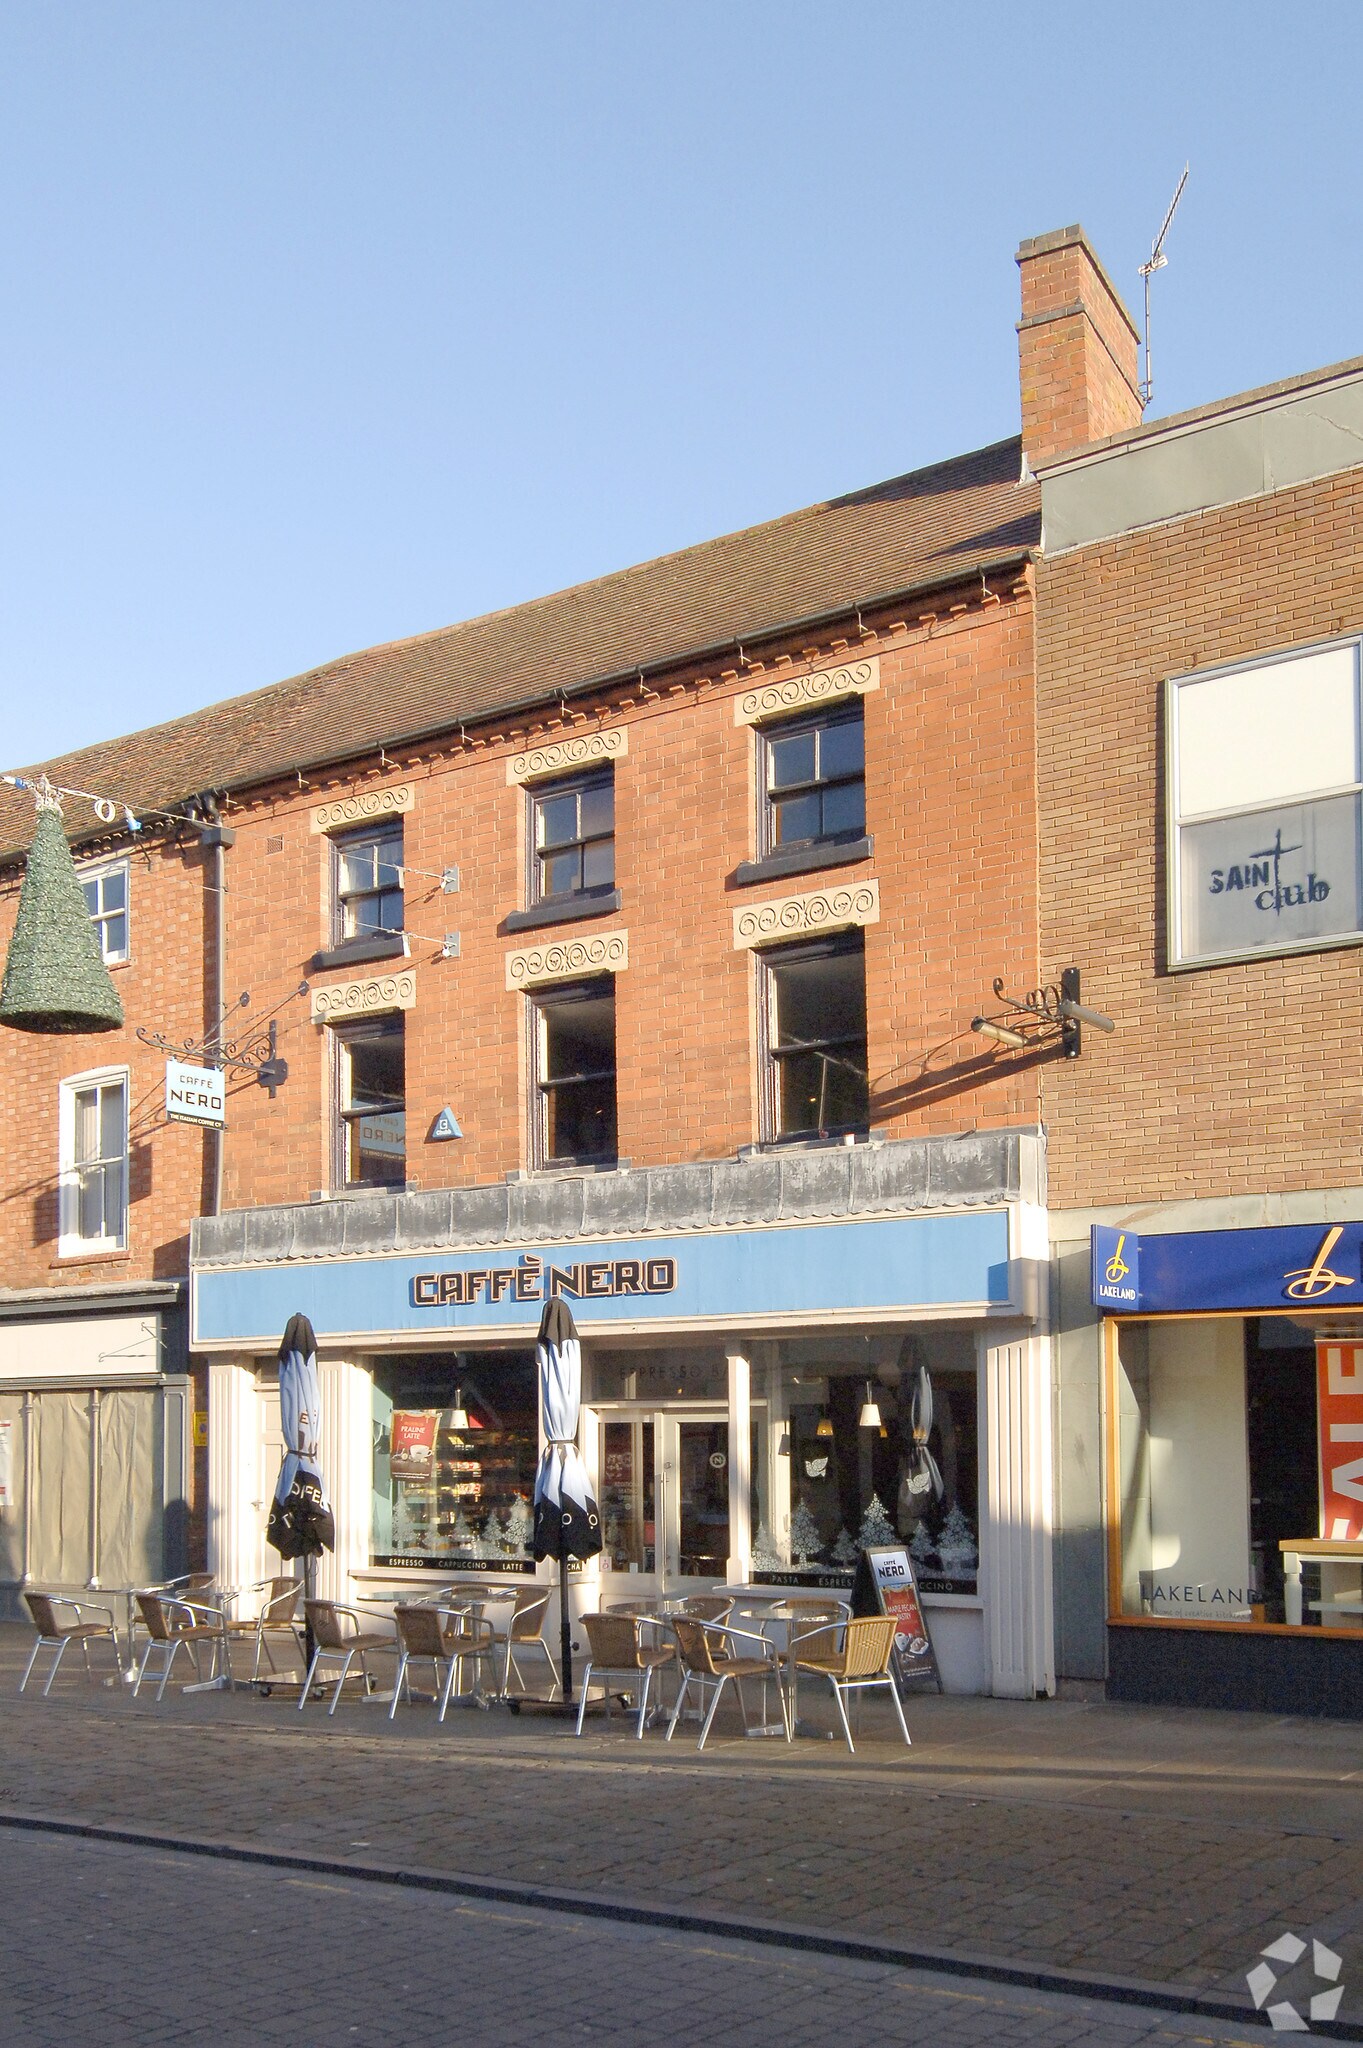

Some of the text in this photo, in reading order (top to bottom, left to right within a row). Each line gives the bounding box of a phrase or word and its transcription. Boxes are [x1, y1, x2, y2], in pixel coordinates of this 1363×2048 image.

[170, 1089, 222, 1110] NERO
[412, 1254, 679, 1305] CAFFÈ NERO
[1099, 1284, 1136, 1301] LAKELAND
[400, 1425, 426, 1434] PRALINE
[403, 1432, 421, 1440] LATTE
[388, 1557, 524, 1572] ESPRESSO CAPPUCCINO LATTE
[566, 1562, 582, 1571] CHA
[877, 1565, 905, 1579] NERO
[771, 1574, 954, 1593] PASTA ESPRES CCINO
[1140, 1584, 1263, 1605] LAKELAND
